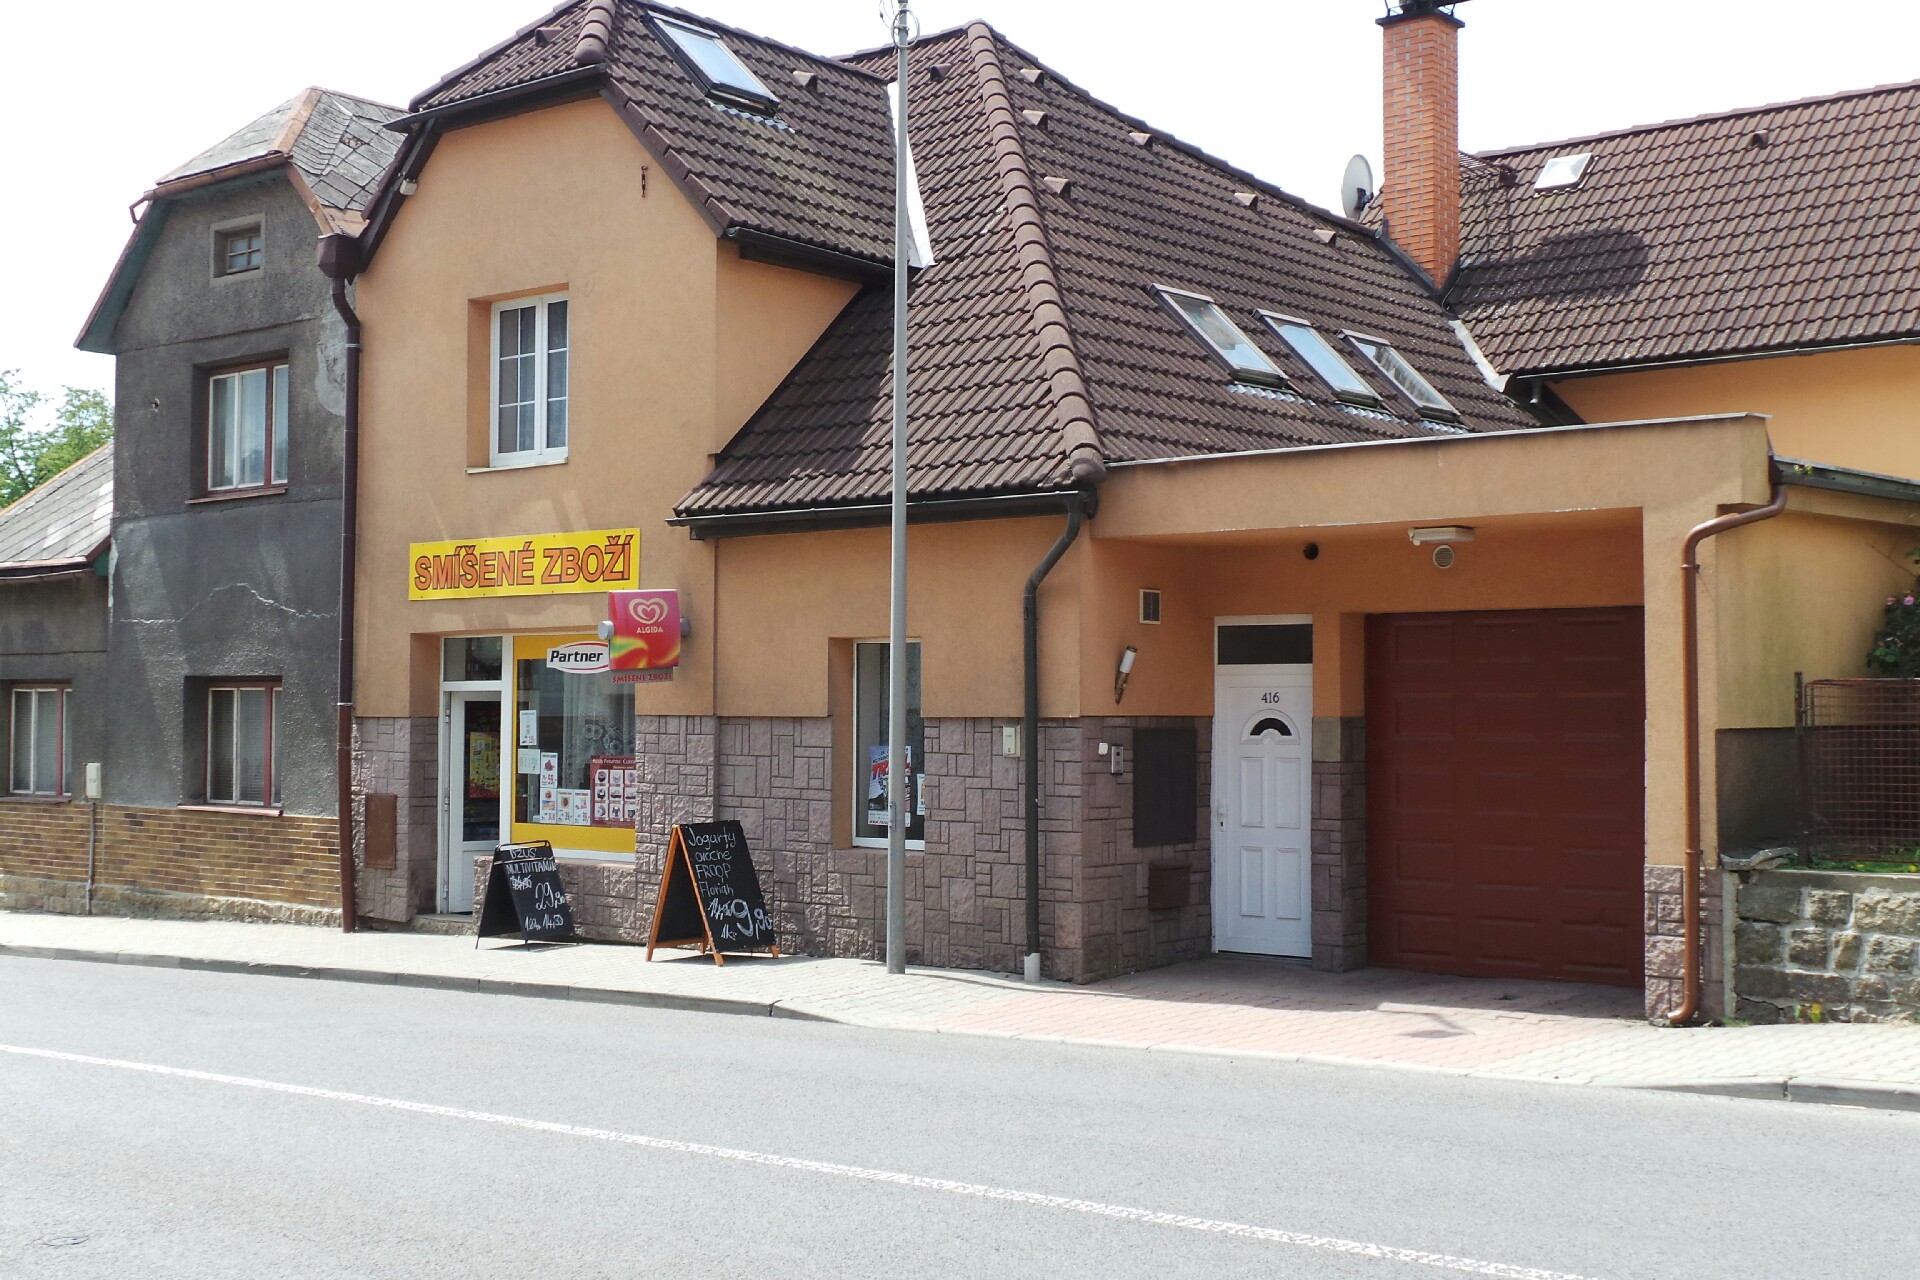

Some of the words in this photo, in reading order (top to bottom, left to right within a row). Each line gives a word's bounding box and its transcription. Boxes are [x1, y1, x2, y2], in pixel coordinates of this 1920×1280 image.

[414, 540, 535, 591] SMÍŠENÉ
[541, 534, 634, 584] ZBOŽÍ
[636, 626, 663, 634] ALGIDA
[550, 650, 603, 663] Partner
[1261, 692, 1280, 704] 416
[688, 826, 736, 850] Jogurty
